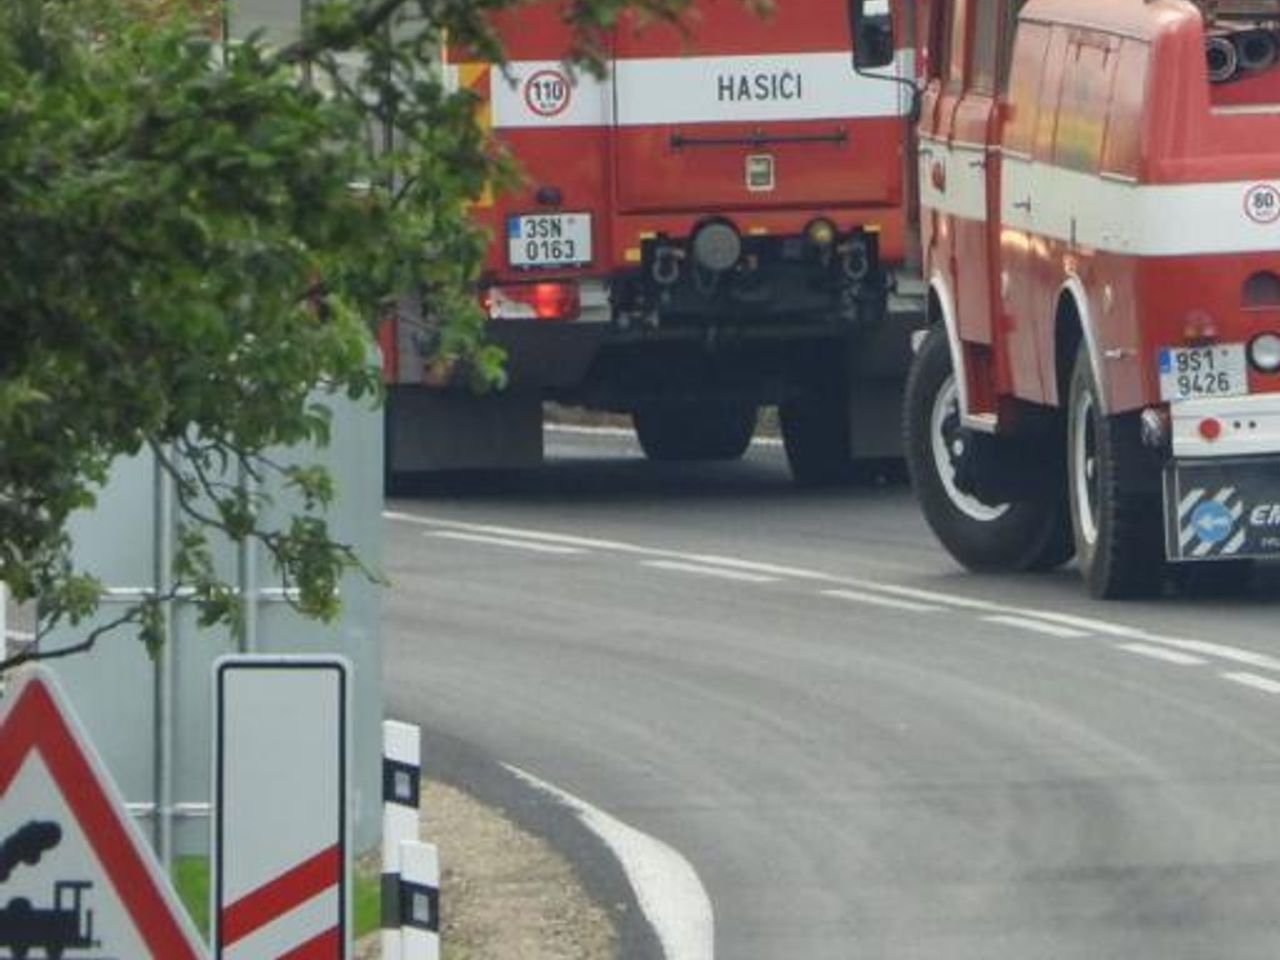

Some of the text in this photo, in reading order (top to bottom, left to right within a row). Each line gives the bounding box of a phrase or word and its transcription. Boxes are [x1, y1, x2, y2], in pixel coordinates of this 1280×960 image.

[533, 81, 562, 101] 110
[1254, 191, 1274, 208] 80
[526, 218, 562, 238] 3SN
[526, 240, 574, 260] 0163
[1178, 372, 1230, 396] 9426
